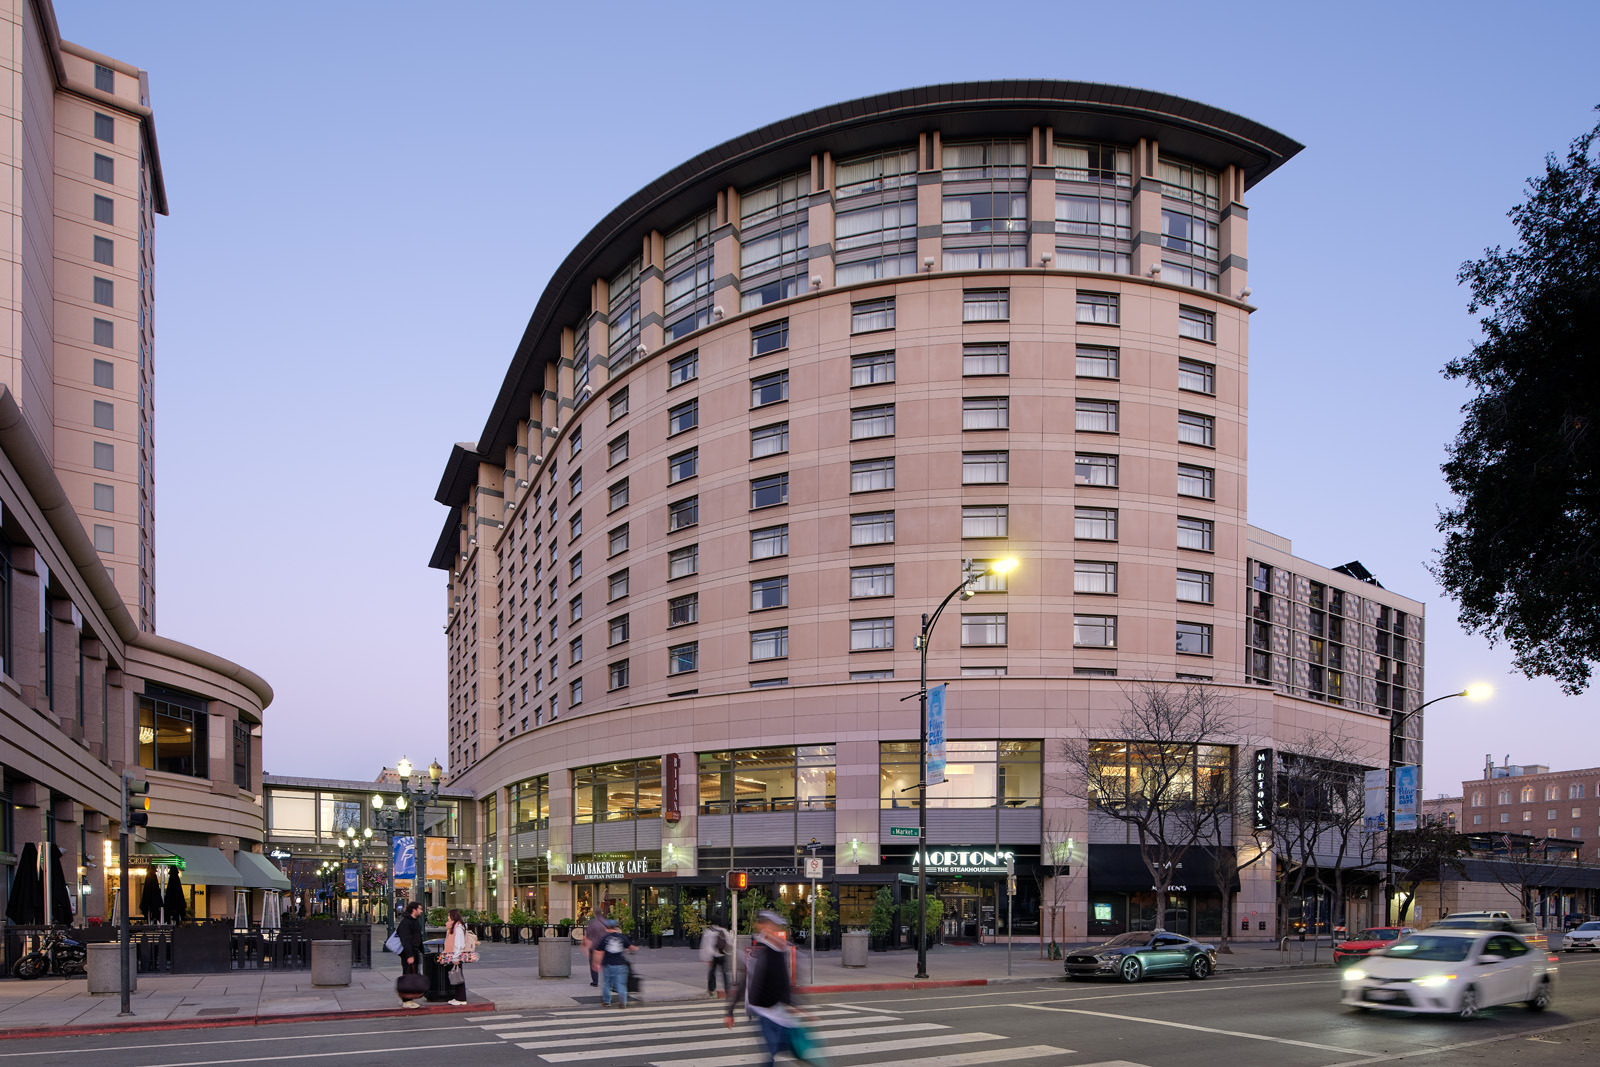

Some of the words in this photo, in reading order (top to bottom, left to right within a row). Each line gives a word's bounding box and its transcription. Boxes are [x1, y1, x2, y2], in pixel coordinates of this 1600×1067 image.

[929, 730, 943, 739] PLAY
[928, 737, 943, 746] DAYS
[895, 828, 913, 836] Market
[912, 851, 1015, 866] MORTON'S
[566, 861, 586, 876] BIJAN
[587, 861, 617, 874] BAKERY
[618, 861, 625, 873] &
[627, 856, 648, 873] CAFÉ
